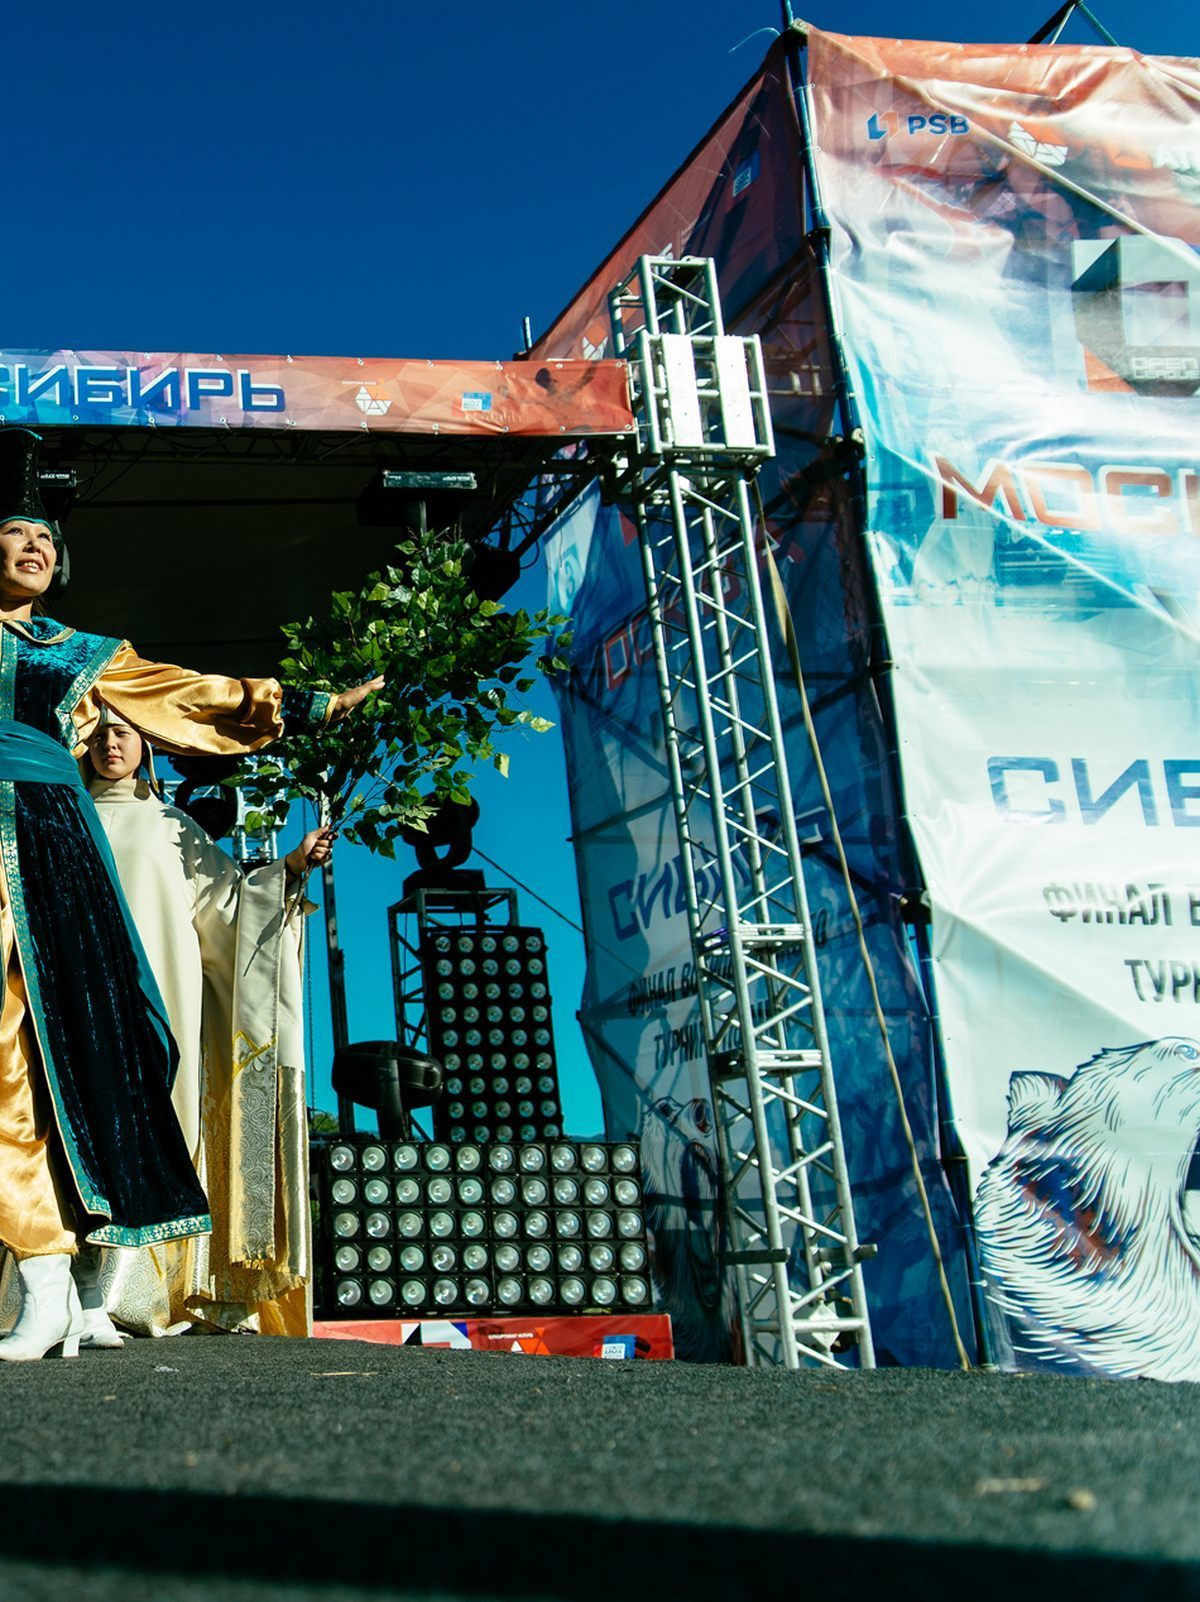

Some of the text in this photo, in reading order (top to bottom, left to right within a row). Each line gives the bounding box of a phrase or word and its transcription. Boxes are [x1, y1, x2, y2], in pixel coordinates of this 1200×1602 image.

[907, 114, 970, 135] PSB
[1131, 357, 1198, 370] OPEN
[1042, 881, 1173, 926] ФИНАЛ
